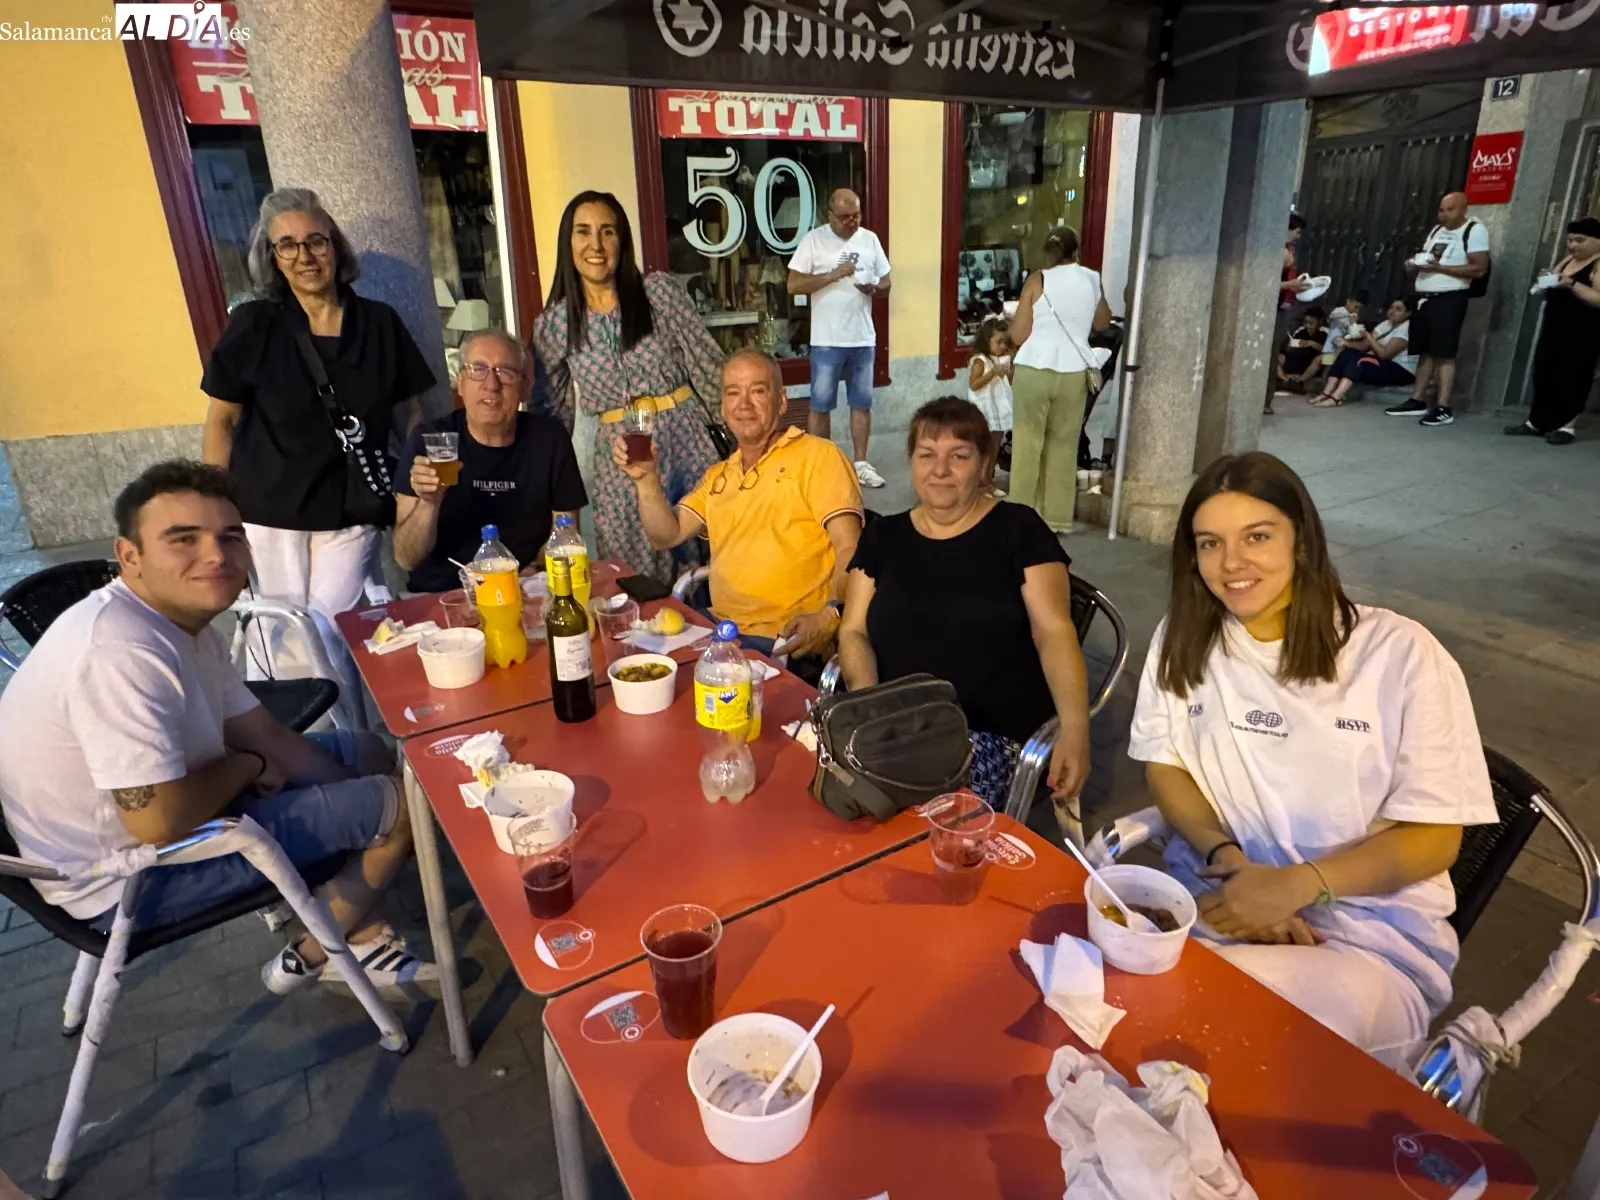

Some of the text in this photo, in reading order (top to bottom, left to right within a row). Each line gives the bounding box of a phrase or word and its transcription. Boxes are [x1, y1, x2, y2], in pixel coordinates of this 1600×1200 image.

[1498, 80, 1515, 97] 12
[668, 98, 857, 138] TOTAL
[682, 146, 817, 257] 50
[473, 479, 516, 489] HILFIGER
[1336, 718, 1371, 733] RSVP
